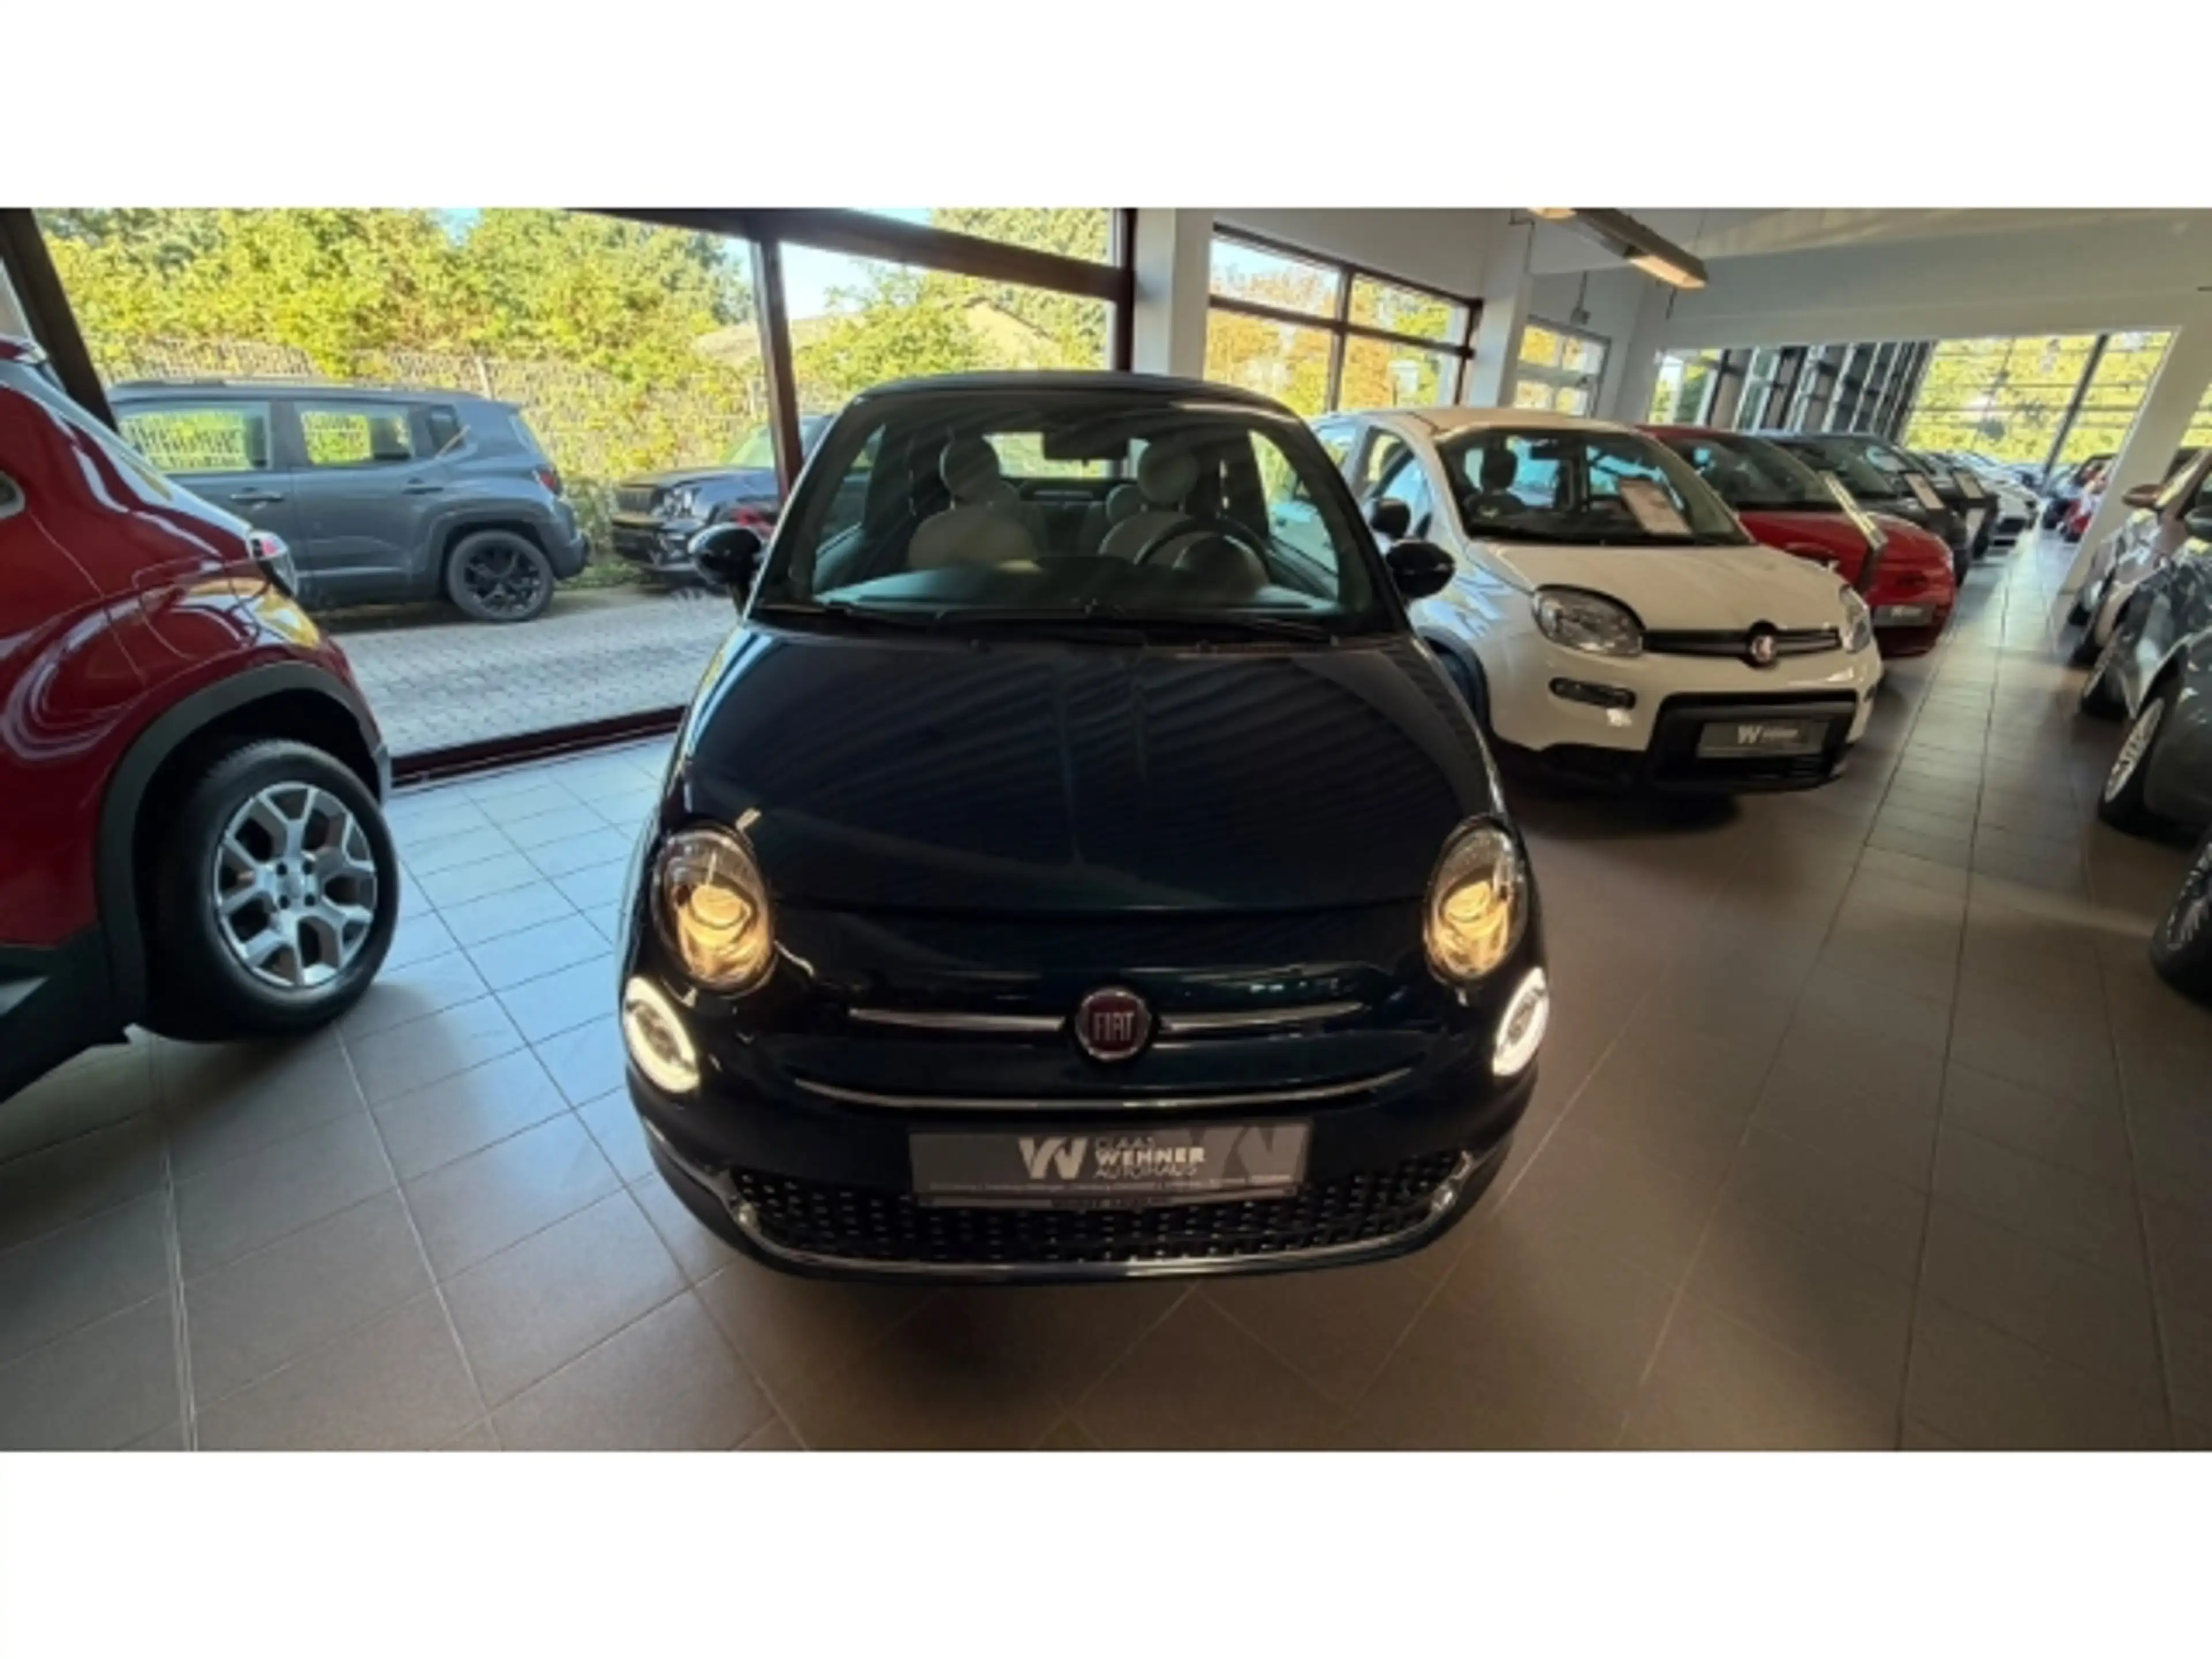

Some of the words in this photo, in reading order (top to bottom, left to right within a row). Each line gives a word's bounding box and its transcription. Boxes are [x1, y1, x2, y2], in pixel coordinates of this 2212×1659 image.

[1093, 1012, 1135, 1041] FIAT
[1095, 1147, 1205, 1166] WEHNER
[1094, 1164, 1198, 1179] AUTOHAUS
